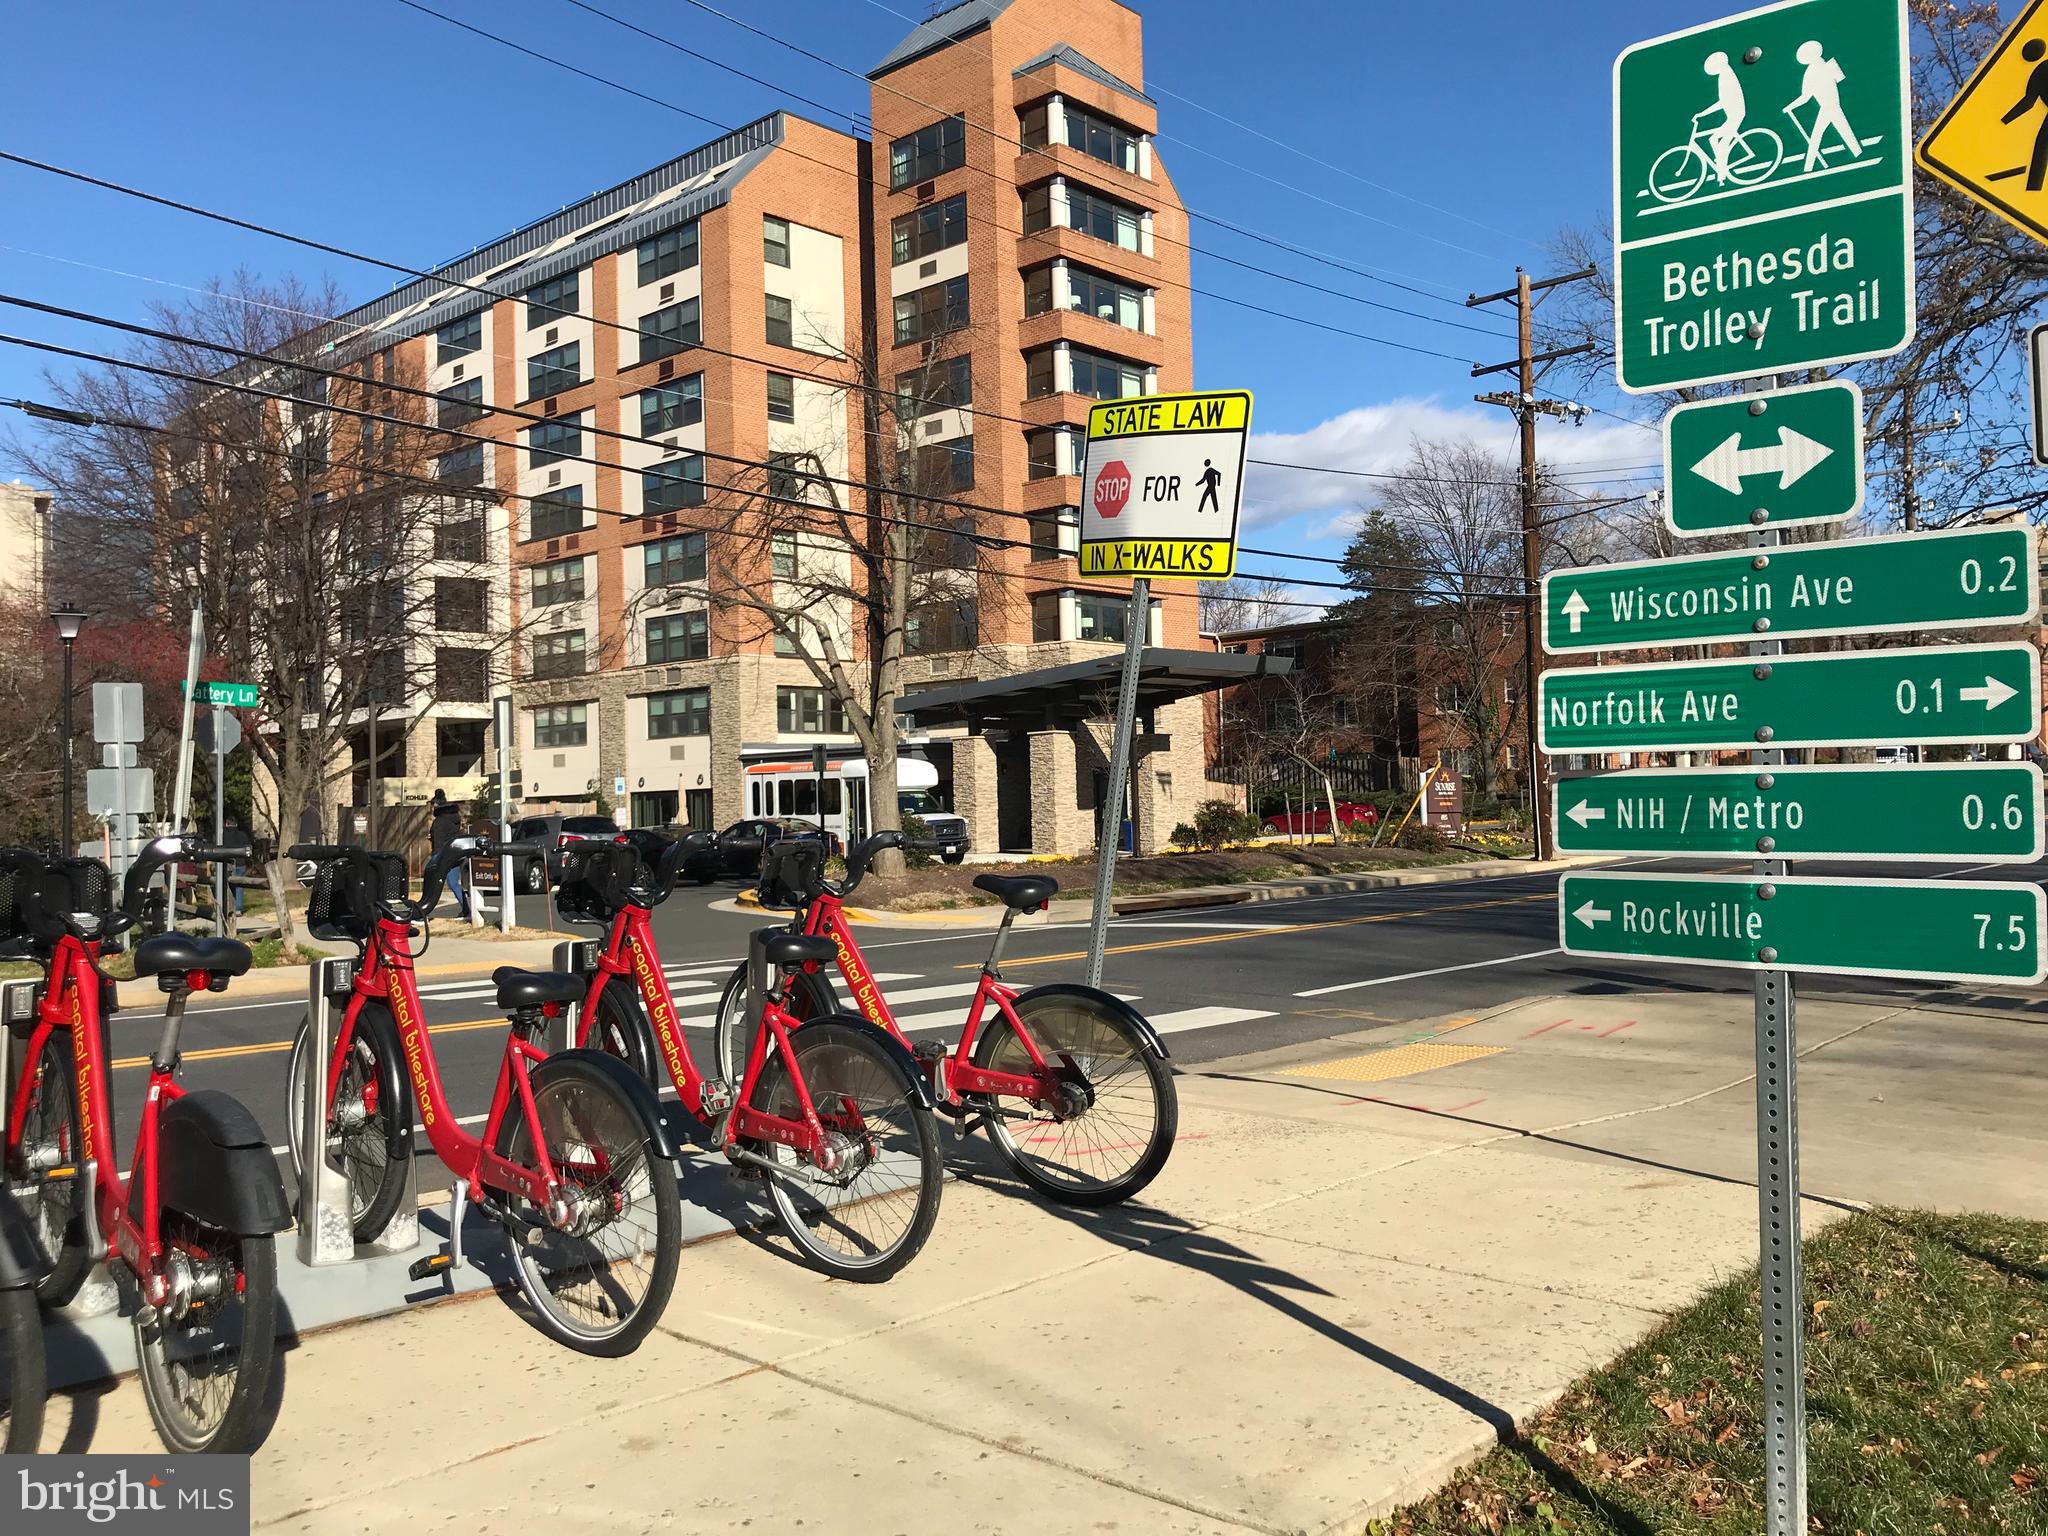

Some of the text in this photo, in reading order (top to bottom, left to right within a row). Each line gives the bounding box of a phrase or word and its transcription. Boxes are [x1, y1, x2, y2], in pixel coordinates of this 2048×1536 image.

[1663, 233, 1855, 302] Bethesda
[1644, 279, 1880, 356] Trolley Trail
[1103, 400, 1226, 435] STATE LAW
[1096, 475, 1181, 503] STOP FOR
[1091, 543, 1214, 571] IN X-WALKS
[1610, 555, 2017, 623] Wisconsin Ave 0.2
[192, 686, 254, 705] attery Ln
[1550, 679, 1943, 728] Norfolk Ave 0.1
[1616, 794, 2024, 834] NIH / Metro 0.6
[1623, 900, 2026, 952] Rockville 7.5
[633, 942, 686, 1088] capital bikeshare
[388, 961, 435, 1126] capital bikeshare
[71, 984, 94, 1160] capital bikeshar
